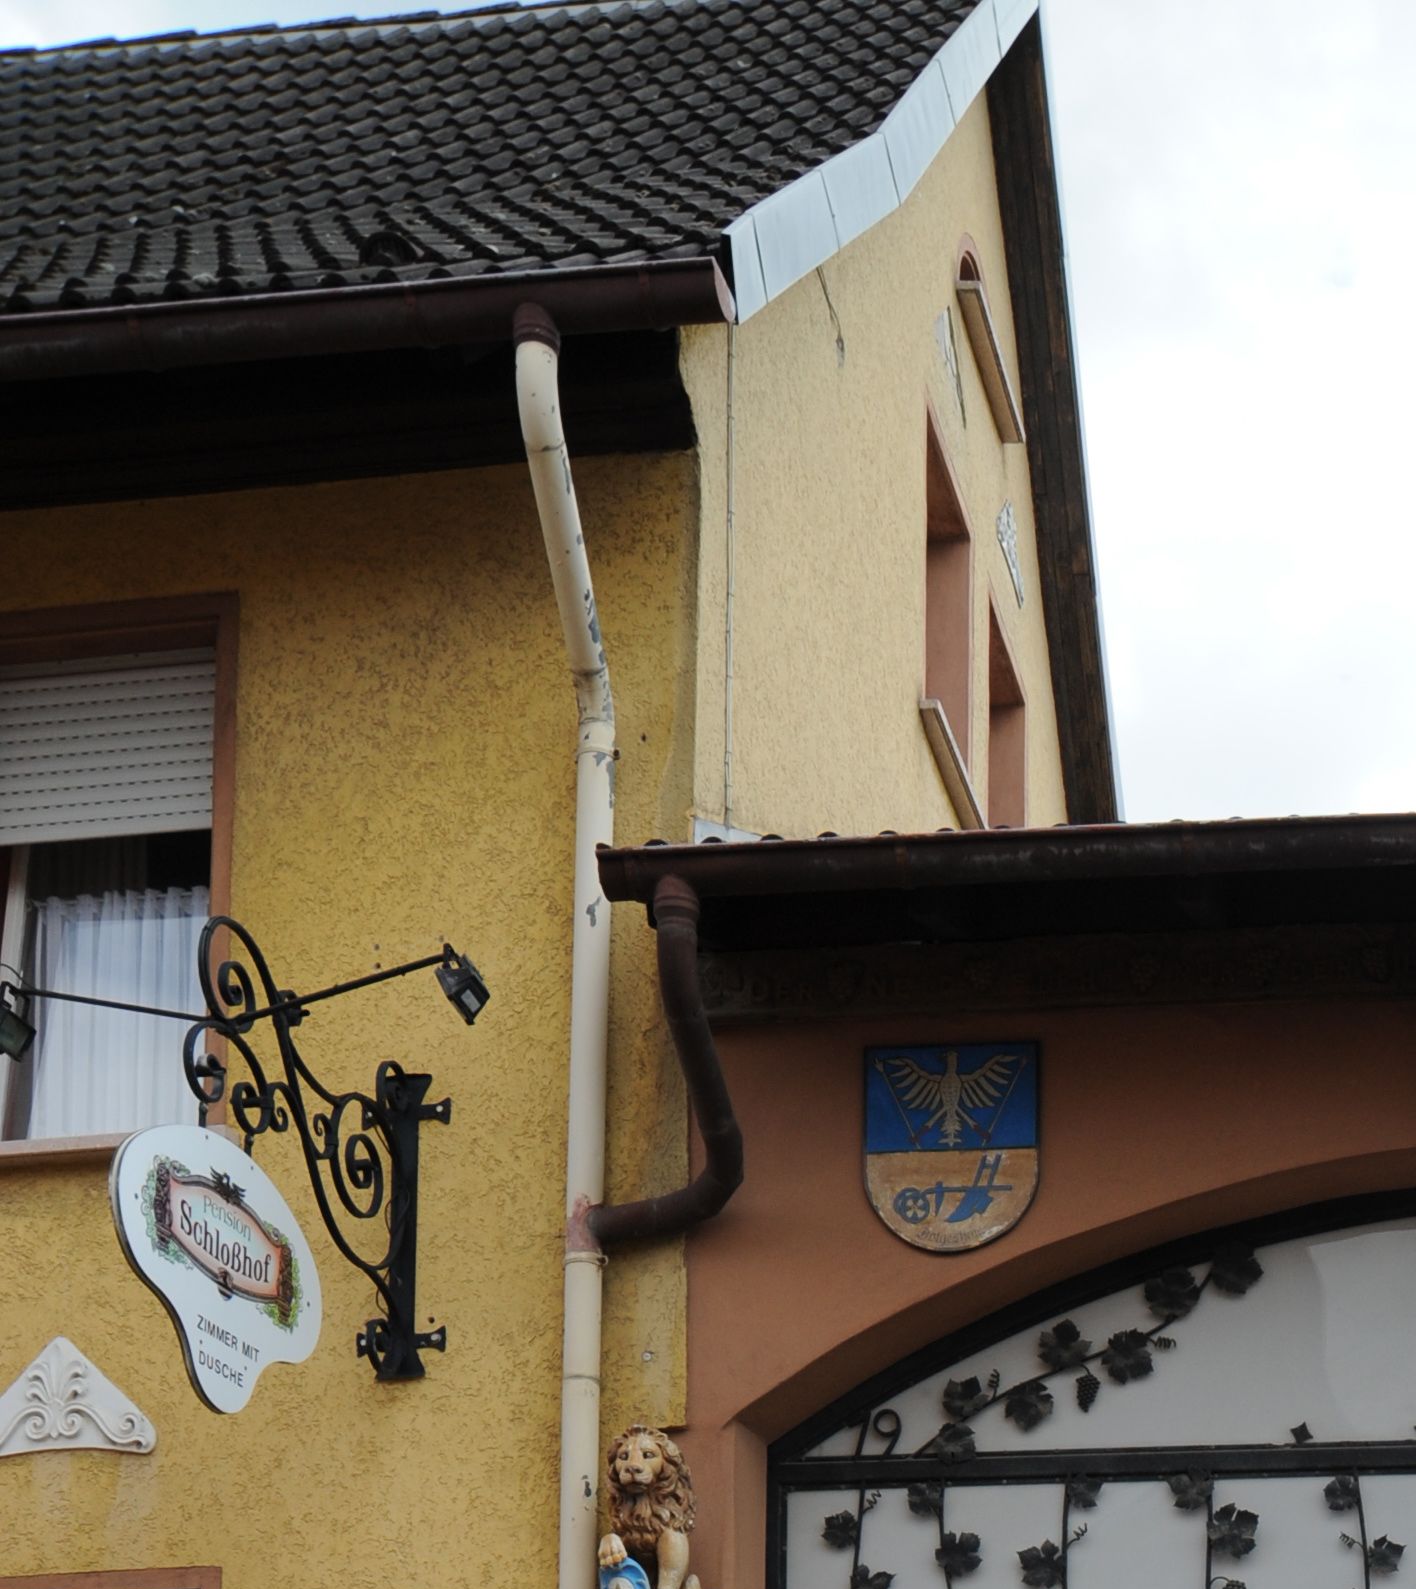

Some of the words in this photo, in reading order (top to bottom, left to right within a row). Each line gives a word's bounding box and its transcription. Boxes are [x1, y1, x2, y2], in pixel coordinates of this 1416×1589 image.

[180, 1200, 272, 1283] Schloßhof
[203, 1193, 251, 1243] Pension
[197, 1315, 238, 1350] ZIMMER
[242, 1341, 259, 1363] MIT
[199, 1351, 244, 1388] DUSCHE
